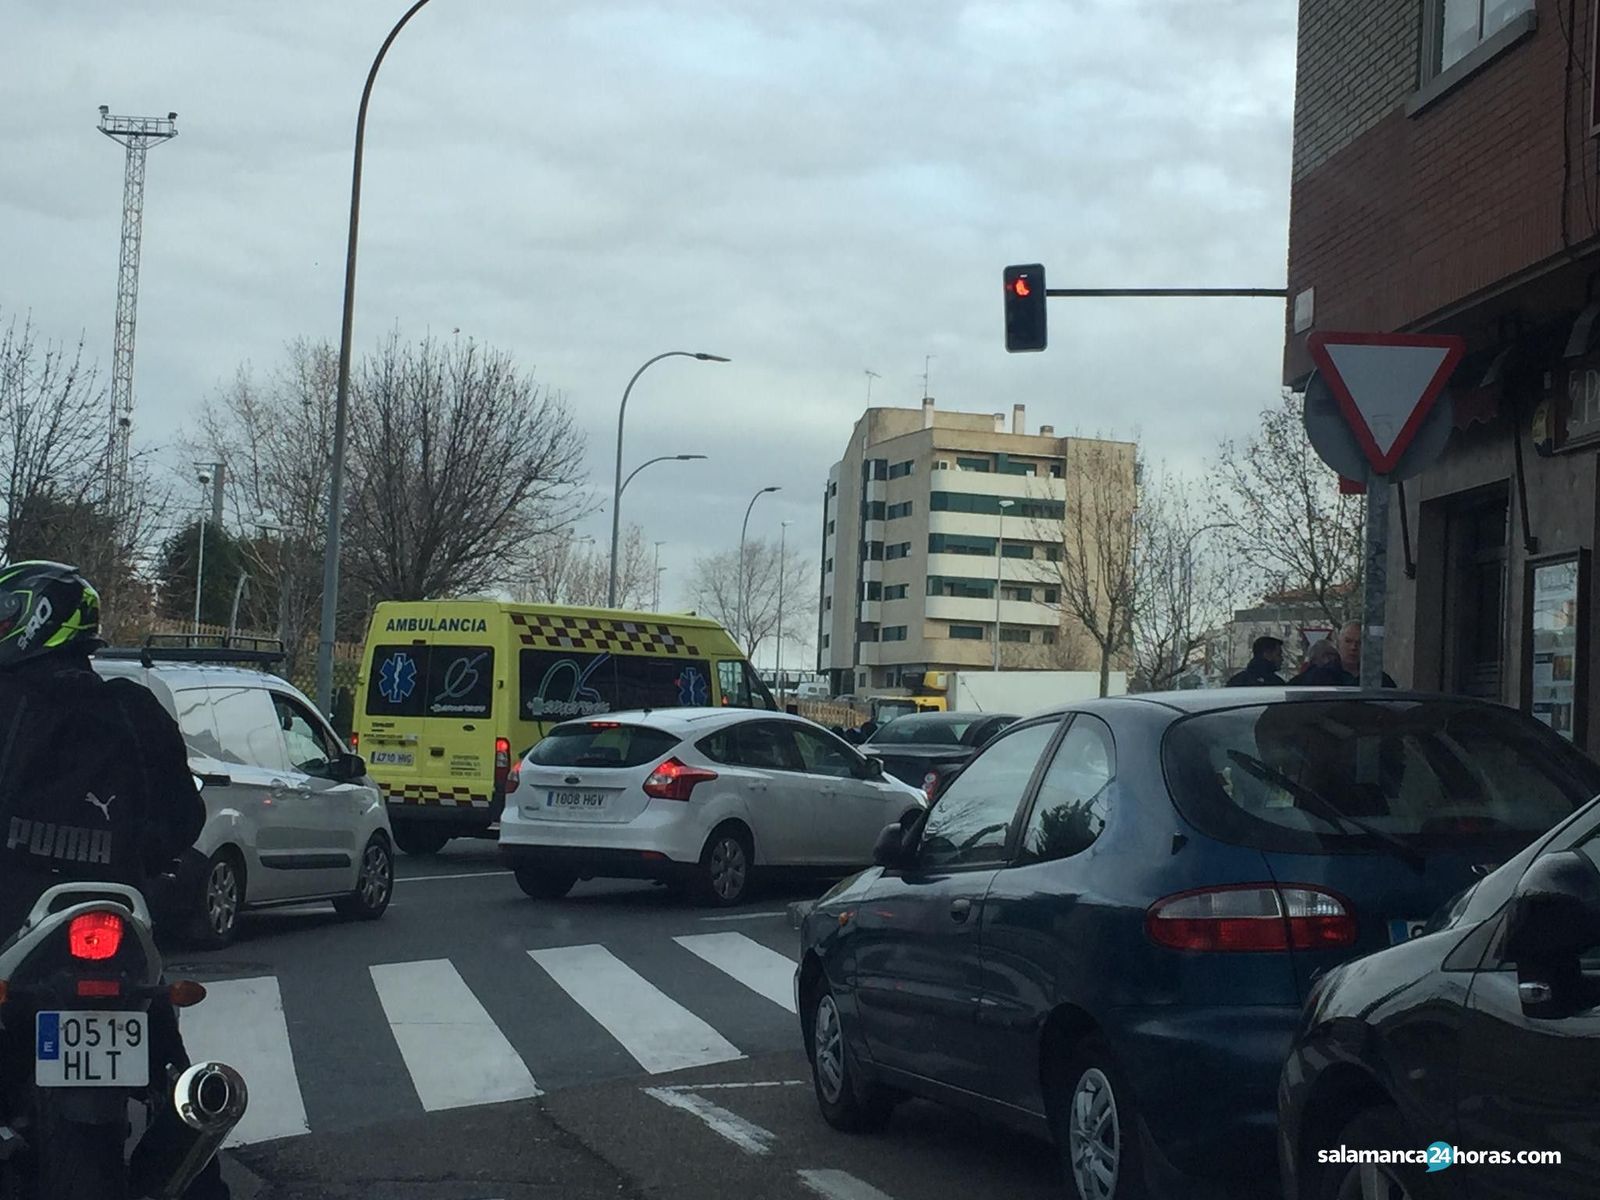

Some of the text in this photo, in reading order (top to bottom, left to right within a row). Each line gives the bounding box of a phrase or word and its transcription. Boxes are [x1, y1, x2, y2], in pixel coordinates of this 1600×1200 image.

[17, 596, 53, 650] SHIRO
[385, 618, 487, 632] AMBULANCIA
[583, 793, 604, 806] HGV
[6, 816, 113, 864] PUMA
[63, 1018, 142, 1048] 0519
[63, 1050, 122, 1081] HLT
